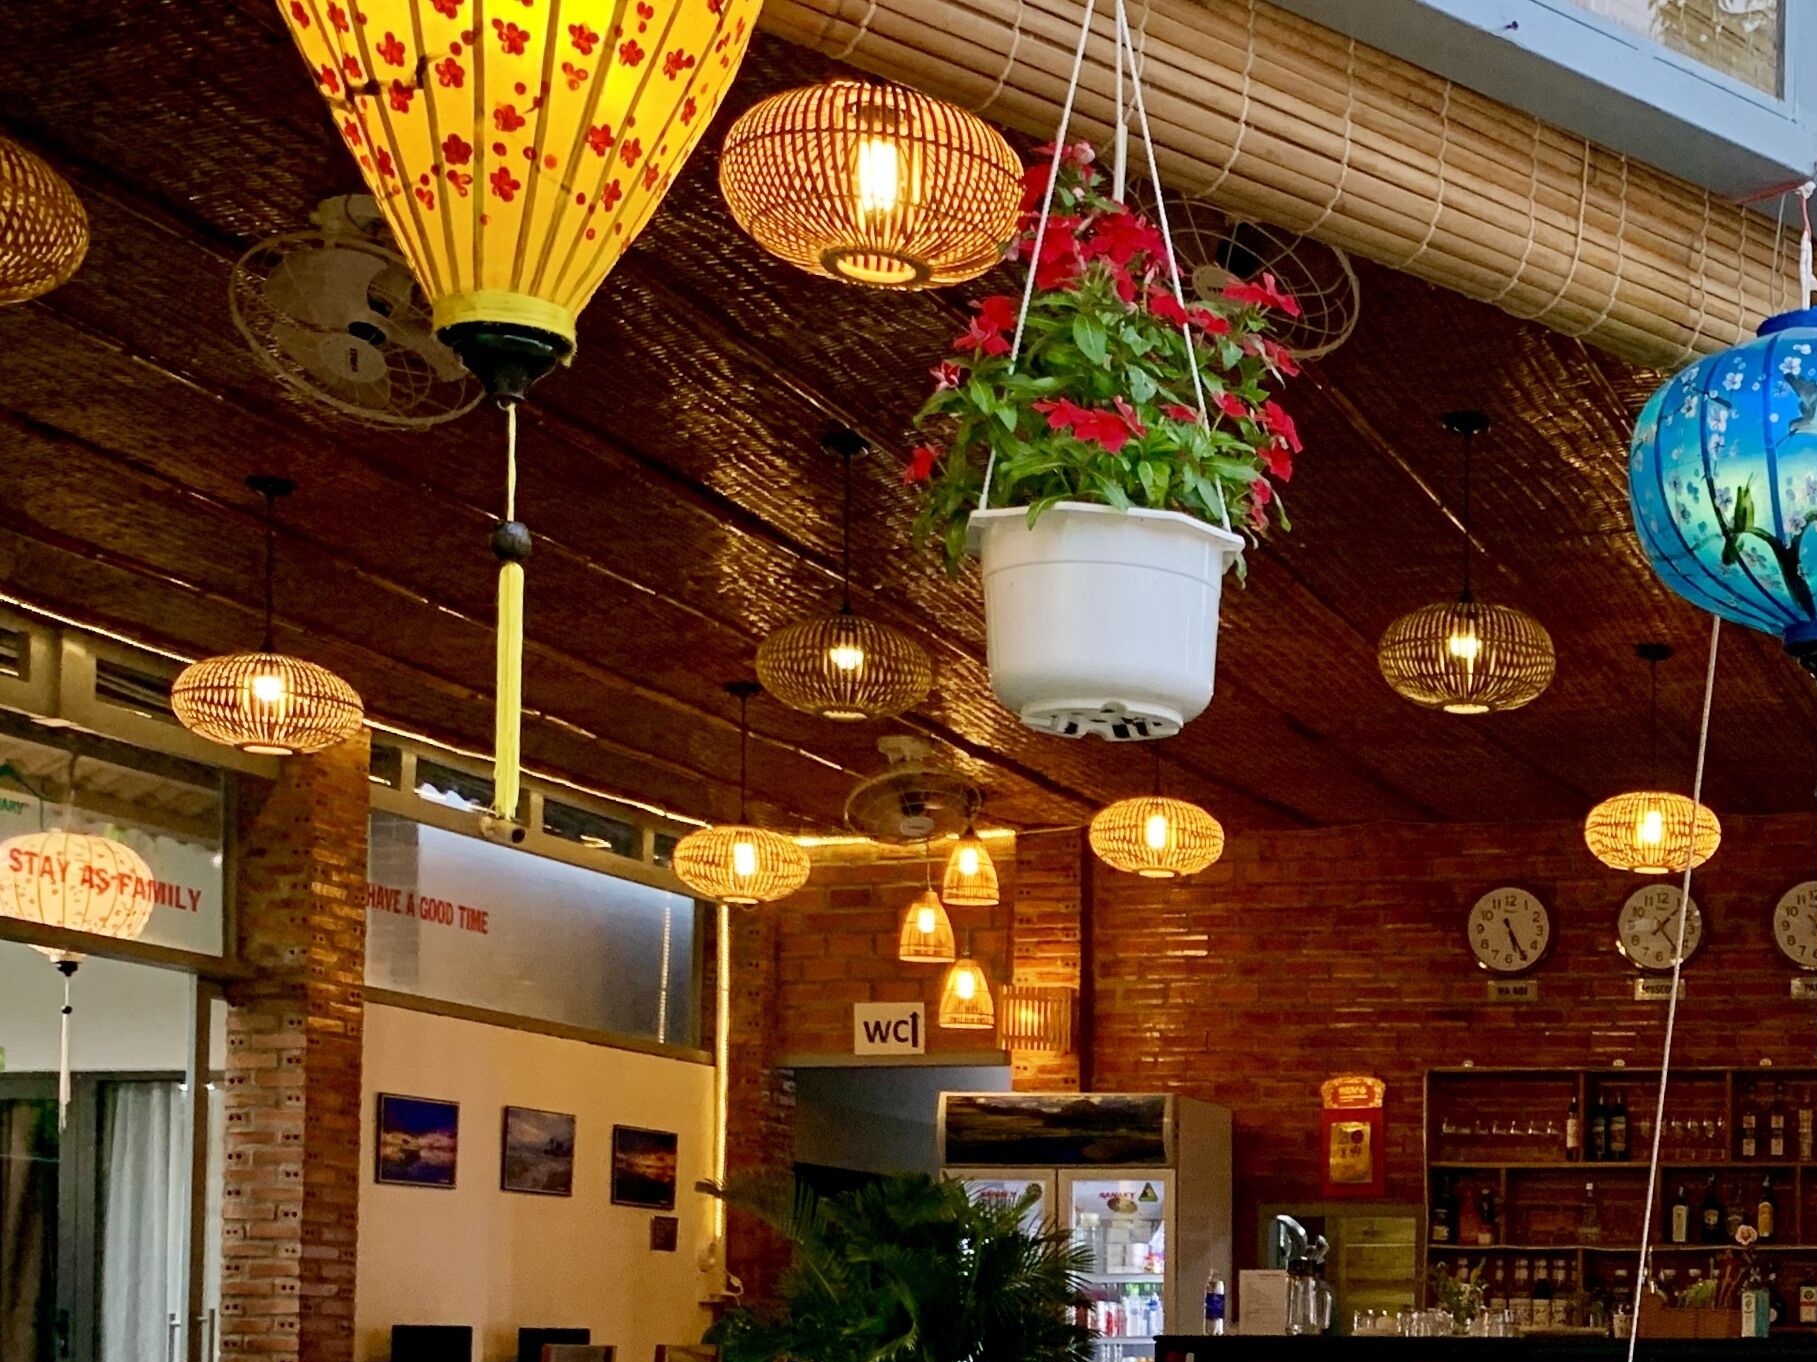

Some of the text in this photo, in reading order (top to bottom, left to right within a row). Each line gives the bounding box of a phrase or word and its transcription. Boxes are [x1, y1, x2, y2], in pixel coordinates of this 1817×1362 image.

[9, 847, 202, 913] STAY AS FAMILY
[366, 883, 489, 934] HAVE A GOOD TIME
[863, 1020, 909, 1043] WC
